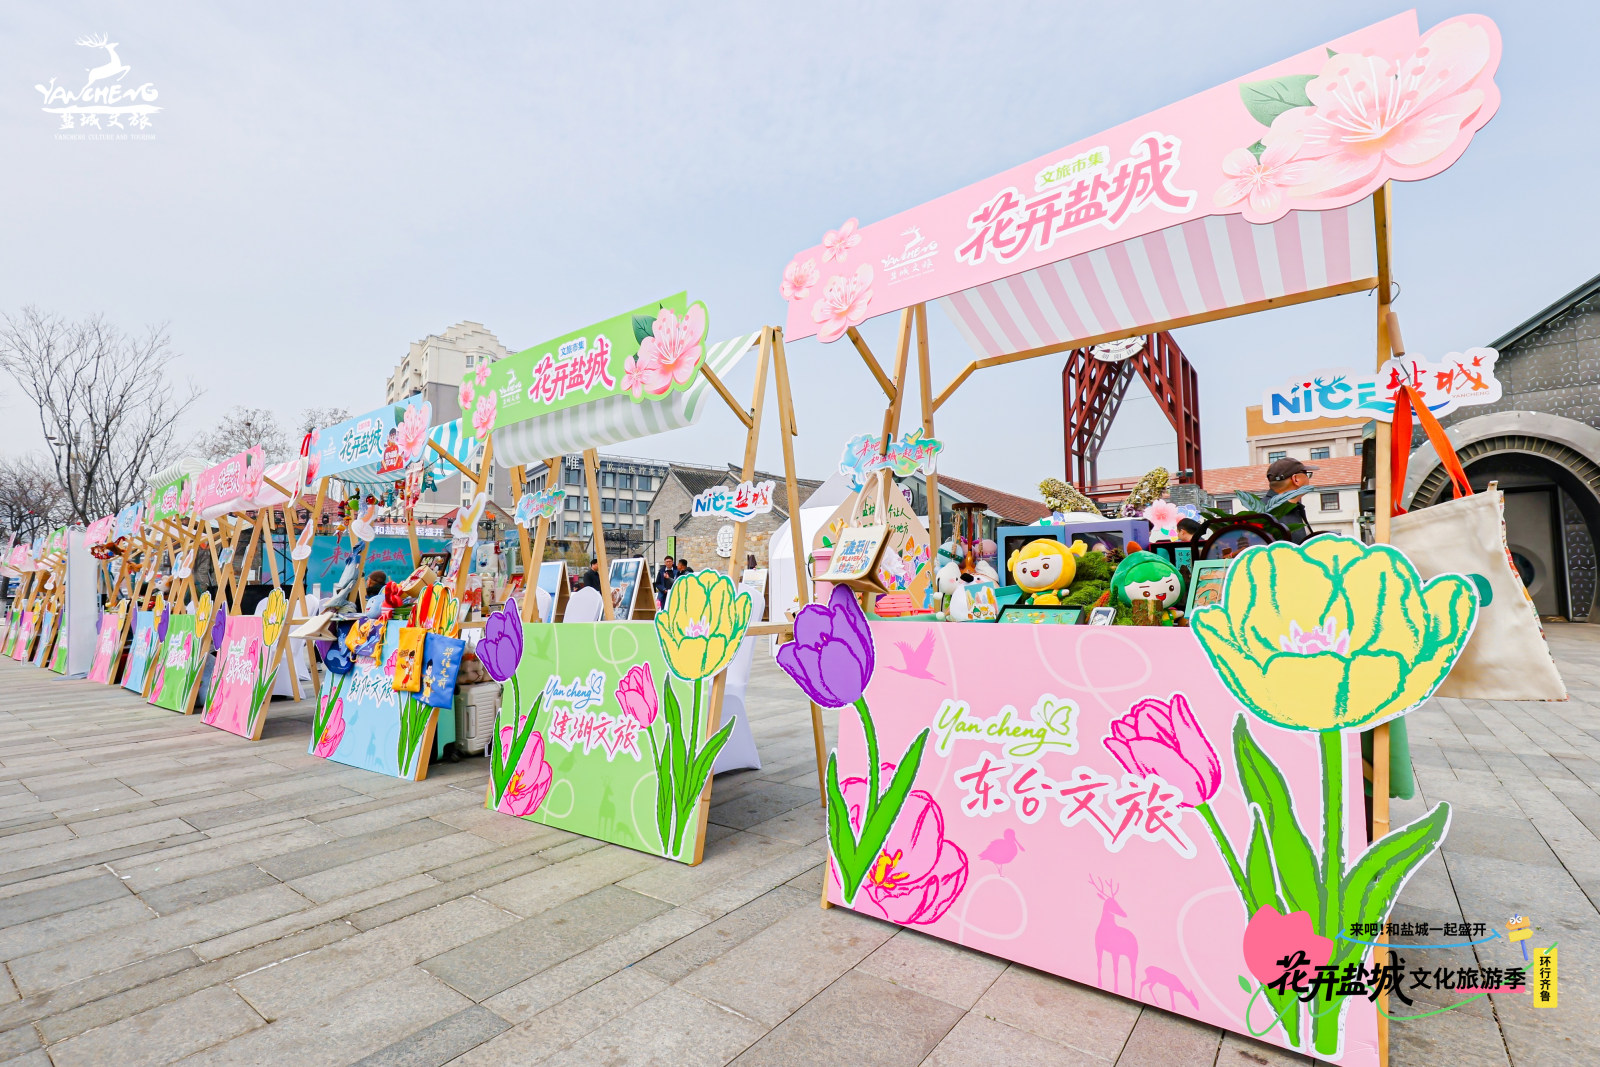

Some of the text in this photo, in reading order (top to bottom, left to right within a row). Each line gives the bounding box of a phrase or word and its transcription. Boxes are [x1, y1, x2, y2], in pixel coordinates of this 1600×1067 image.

[1040, 151, 1104, 187] 文旅市集
[959, 137, 1191, 260] 花开盐城
[529, 337, 614, 402] 花开盐城
[1271, 375, 1377, 416] NICE
[1451, 391, 1491, 399] YANCHENG
[339, 419, 383, 462] 花开盐城
[545, 678, 601, 709] Yan cheng
[550, 710, 639, 757] 建湖文旅
[937, 705, 1072, 756] Yan cheng
[960, 758, 1188, 851] 东台文旅
